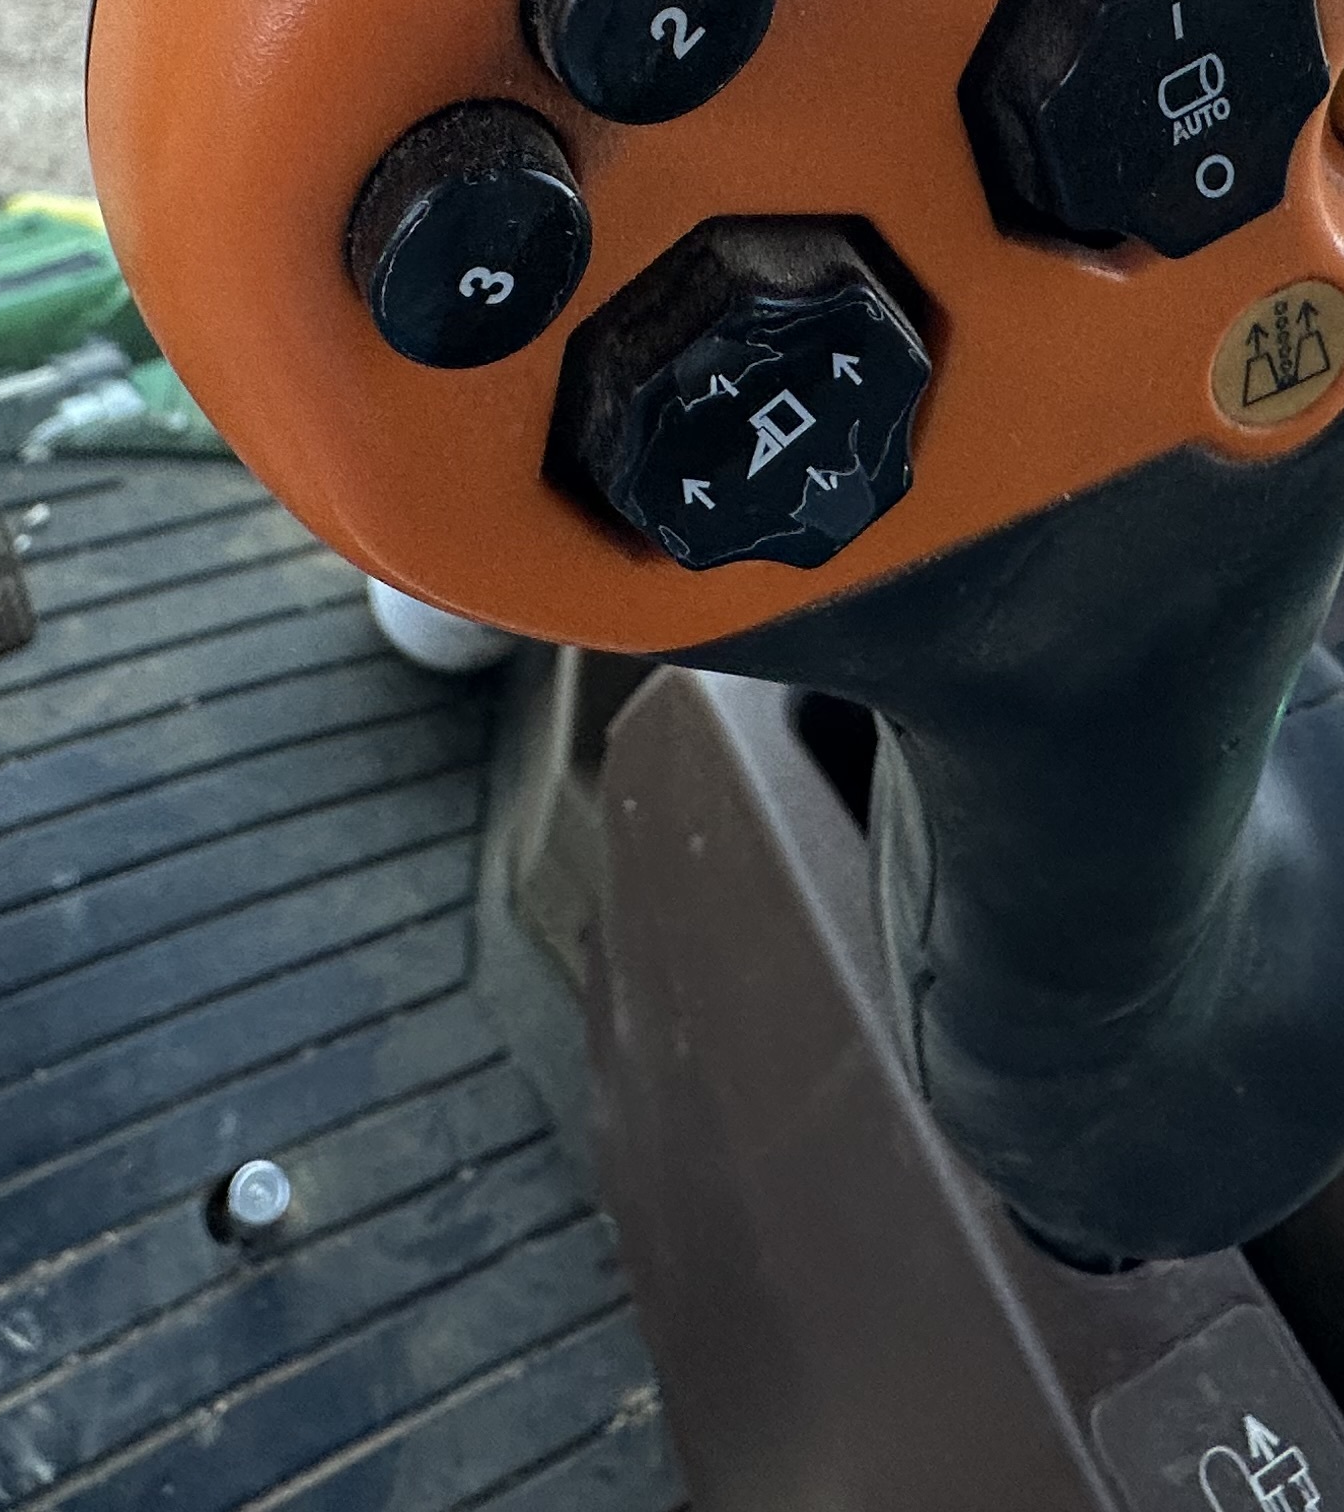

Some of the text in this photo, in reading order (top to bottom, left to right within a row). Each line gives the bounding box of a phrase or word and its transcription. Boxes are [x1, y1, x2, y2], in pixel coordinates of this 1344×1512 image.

[650, 6, 706, 60] 2
[1172, 96, 1231, 147] AUTO
[458, 266, 515, 304] 3
